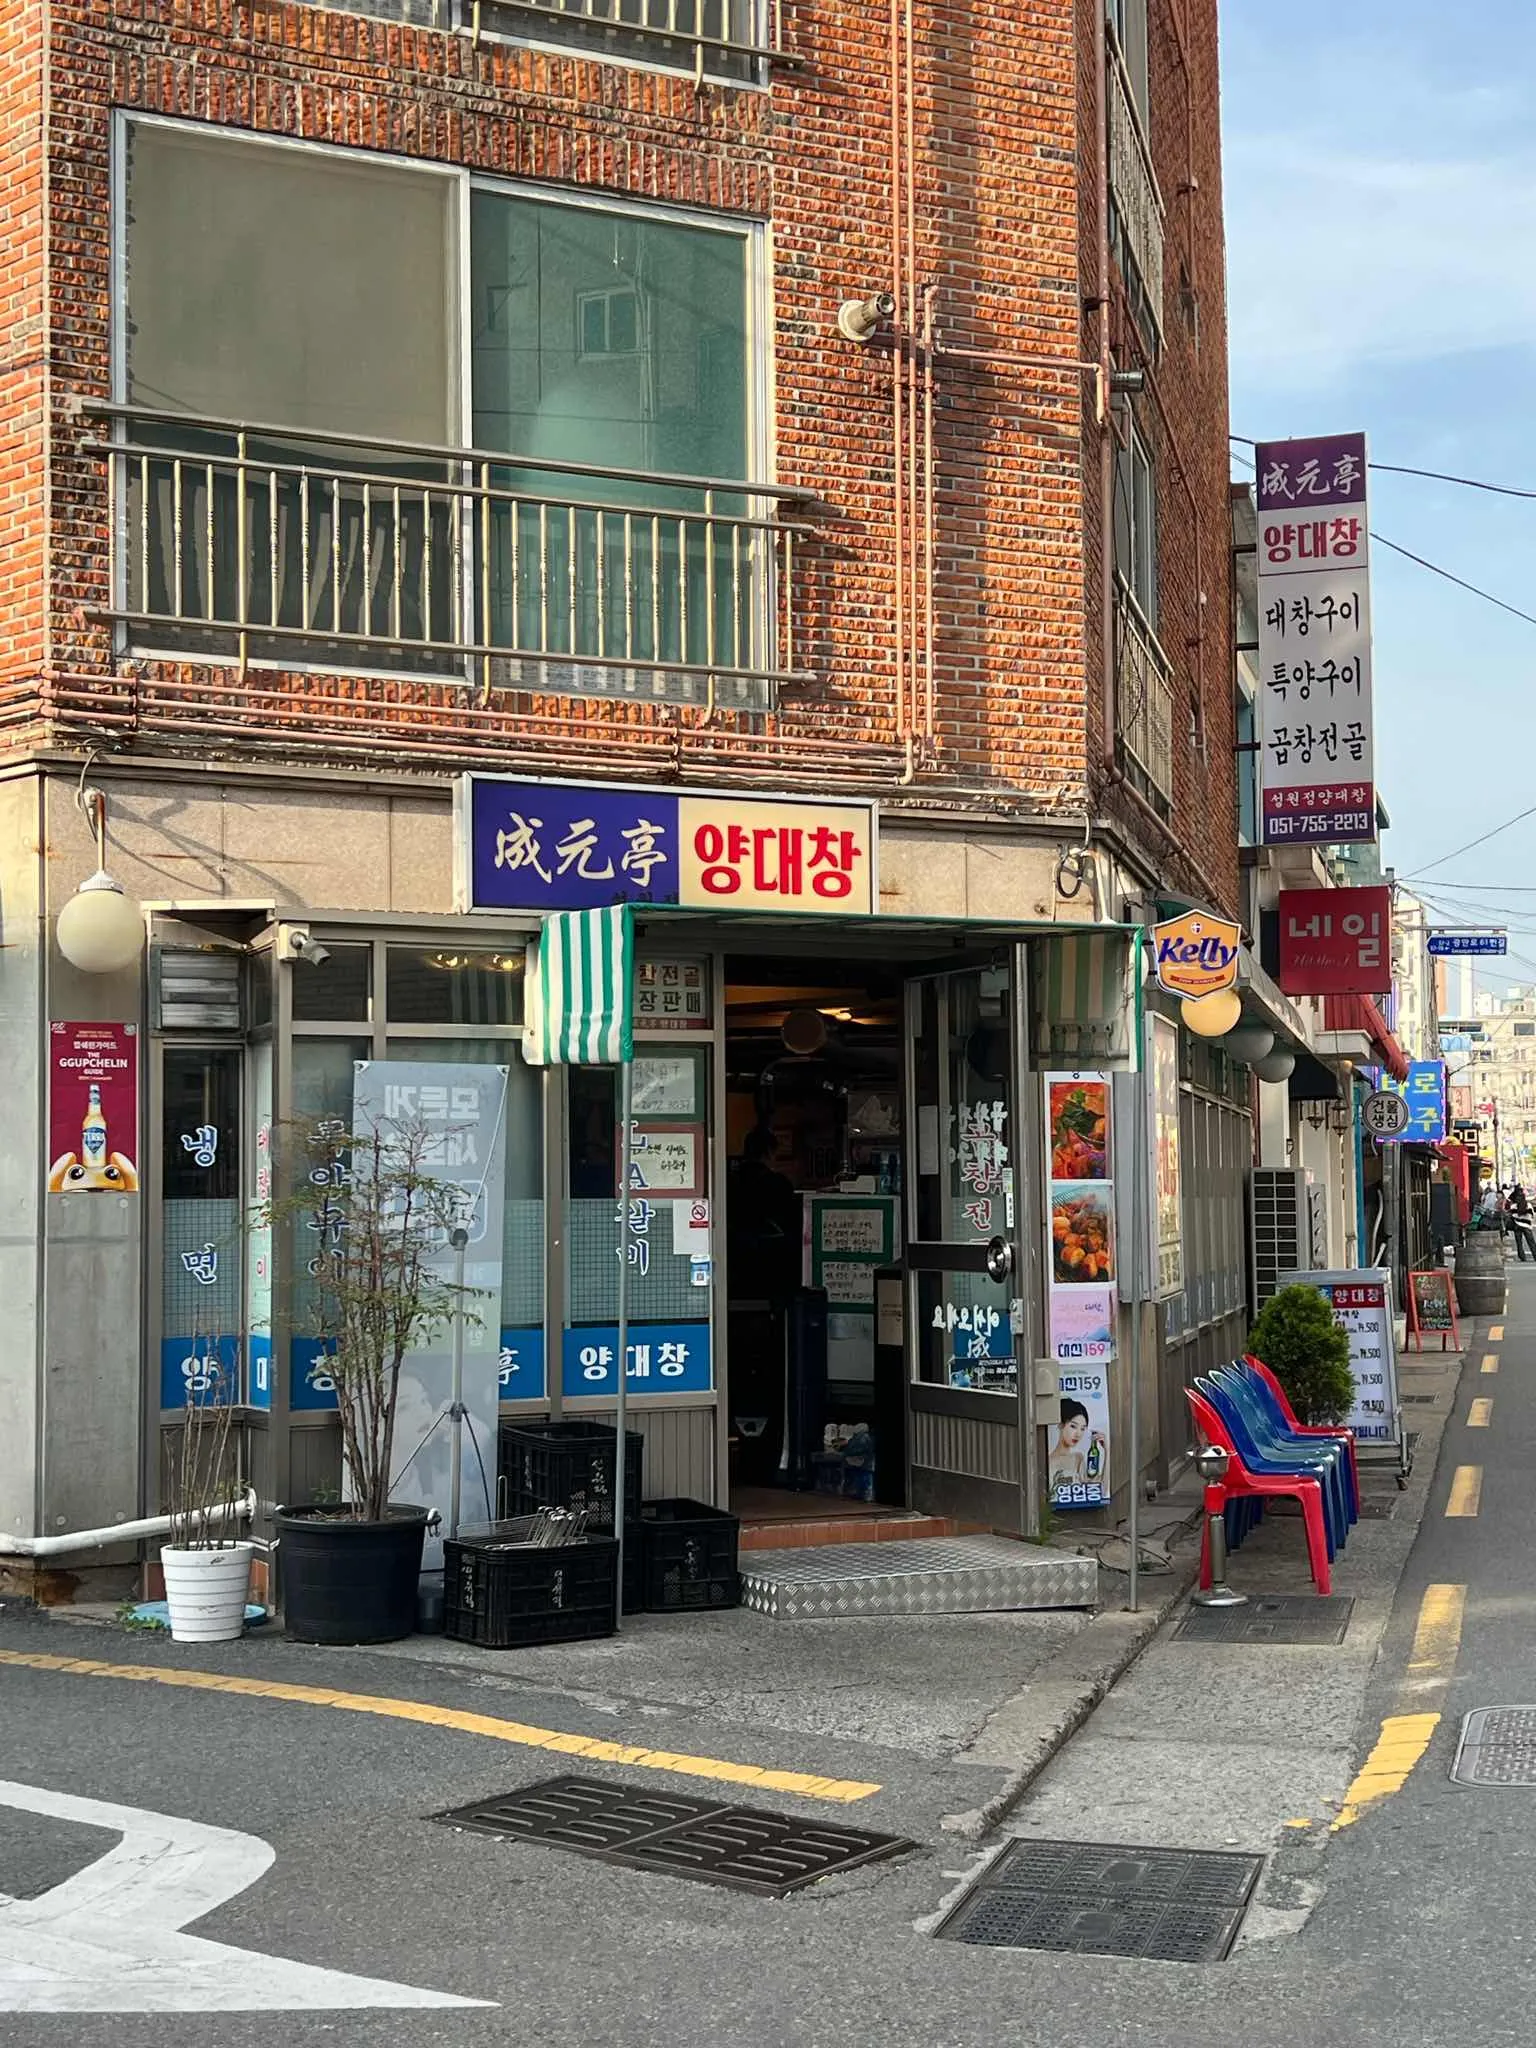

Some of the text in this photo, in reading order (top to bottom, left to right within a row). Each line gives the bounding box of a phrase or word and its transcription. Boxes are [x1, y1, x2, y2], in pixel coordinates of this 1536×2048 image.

[1261, 453, 1361, 500] 成元亭
[1264, 517, 1363, 563] 양대창
[1265, 592, 1360, 639] 대창구이
[1266, 656, 1362, 702] 특양구이
[1268, 721, 1367, 766] 곱창전골
[1269, 812, 1369, 835] 051-755-2213
[494, 811, 668, 887] 成元亭
[694, 823, 862, 898] 양대창
[1158, 936, 1238, 972] Kelly
[1288, 912, 1380, 968] 네일
[59, 1057, 129, 1068] GGUPCHELIN
[1373, 1100, 1398, 1114] 건물
[579, 1342, 690, 1381] 양대창
[1056, 1482, 1103, 1503] 영업중
